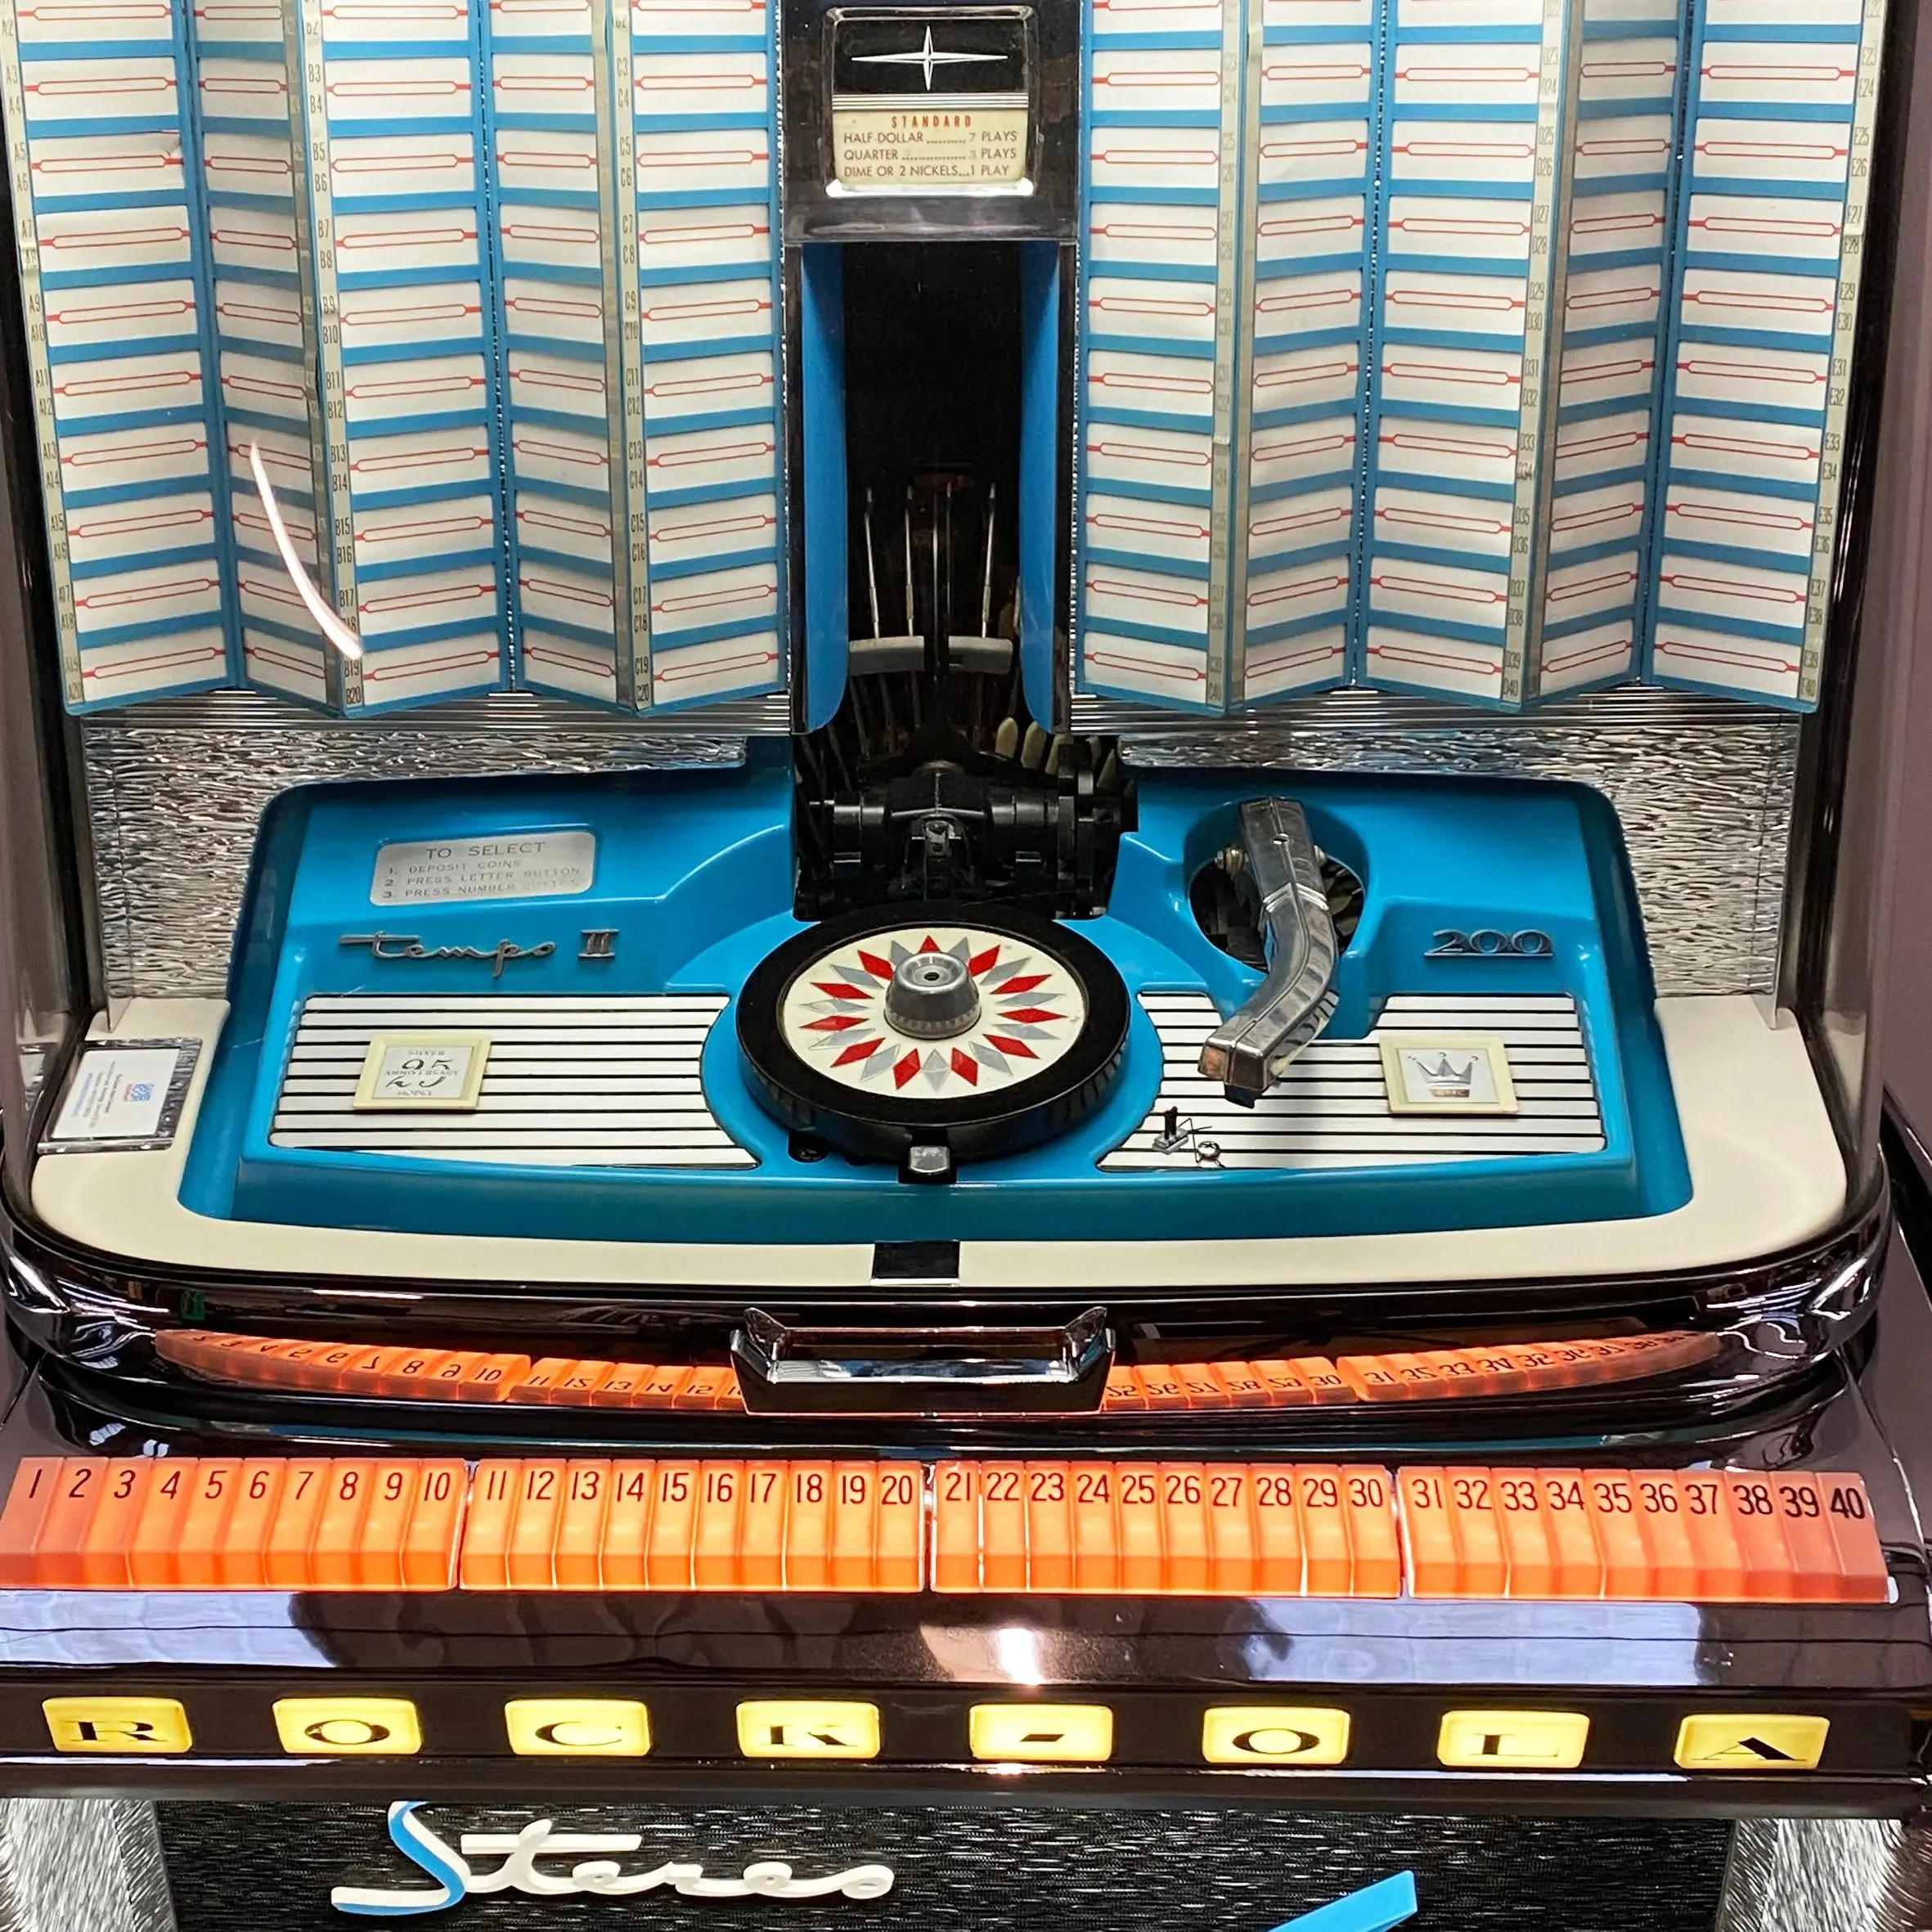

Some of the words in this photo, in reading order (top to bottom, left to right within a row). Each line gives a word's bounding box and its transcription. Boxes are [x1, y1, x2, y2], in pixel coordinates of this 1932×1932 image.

[308, 64, 321, 82] B3
[310, 95, 322, 114] B4
[892, 115, 972, 128] STANDARD
[982, 131, 1017, 142] PLAYS
[313, 142, 326, 160] B5
[844, 150, 898, 160] QUARTER
[982, 148, 1017, 159] PLAYS
[844, 166, 872, 176] DIME
[877, 166, 893, 176] OR
[900, 165, 906, 176] 2
[982, 165, 1009, 176] PLAY
[315, 173, 327, 191] B6
[318, 220, 329, 237] B7
[320, 249, 332, 267] B8
[323, 295, 335, 312] B9
[323, 326, 338, 344] B10
[326, 371, 339, 389] B11
[328, 401, 343, 418] B12
[330, 445, 346, 462] B13
[332, 474, 347, 491] B14
[335, 519, 350, 535] B15
[337, 546, 352, 563] B16
[339, 589, 353, 606] B17
[344, 658, 359, 676] B19
[347, 685, 361, 703] B20
[426, 848, 452, 860] TO
[468, 842, 546, 857] SELECT
[409, 863, 467, 874] DEPOSIT
[478, 860, 521, 869] COINS
[407, 876, 452, 885] PRESS
[461, 871, 514, 882] LETTER
[405, 887, 450, 897] PRESS
[458, 883, 516, 895] NUMBER
[1424, 928, 1553, 957] 200
[29, 1468, 43, 1499] 1
[68, 1468, 92, 1498] 2
[114, 1469, 136, 1499] 3
[160, 1471, 181, 1499] 4
[204, 1470, 227, 1499] 5
[249, 1471, 269, 1499] 6
[295, 1471, 314, 1500] 7
[339, 1471, 358, 1500] 8
[384, 1472, 402, 1501] 9
[424, 1472, 451, 1502] 10
[487, 1471, 507, 1500] 11
[527, 1471, 555, 1500] 12
[572, 1471, 600, 1500] 13
[617, 1472, 644, 1502] 14
[662, 1472, 689, 1502] 15
[708, 1473, 734, 1503] 16
[750, 1473, 776, 1503] 17
[797, 1473, 822, 1503] 18
[842, 1475, 865, 1504] 19
[881, 1475, 913, 1505] 20
[946, 1472, 971, 1501] 21
[986, 1471, 1019, 1501] 22
[1031, 1472, 1064, 1502] 23
[1076, 1474, 1110, 1503] 24
[1121, 1475, 1155, 1504] 25
[1166, 1475, 1201, 1504] 26
[1211, 1477, 1242, 1507] 27
[1256, 1477, 1292, 1507] 28
[1303, 1478, 1338, 1507] 29
[1349, 1478, 1383, 1507] 30
[1413, 1479, 1442, 1508] 31
[1453, 1480, 1492, 1510] 32
[1500, 1481, 1539, 1511] 33
[1546, 1480, 1584, 1511] 34
[1593, 1483, 1633, 1513] 35
[1639, 1483, 1678, 1513] 36
[1684, 1484, 1718, 1515] 37
[1732, 1485, 1773, 1516] 38
[1778, 1485, 1820, 1518] 39
[1830, 1487, 1866, 1520] 40
[330, 1799, 895, 1916] Stereo
